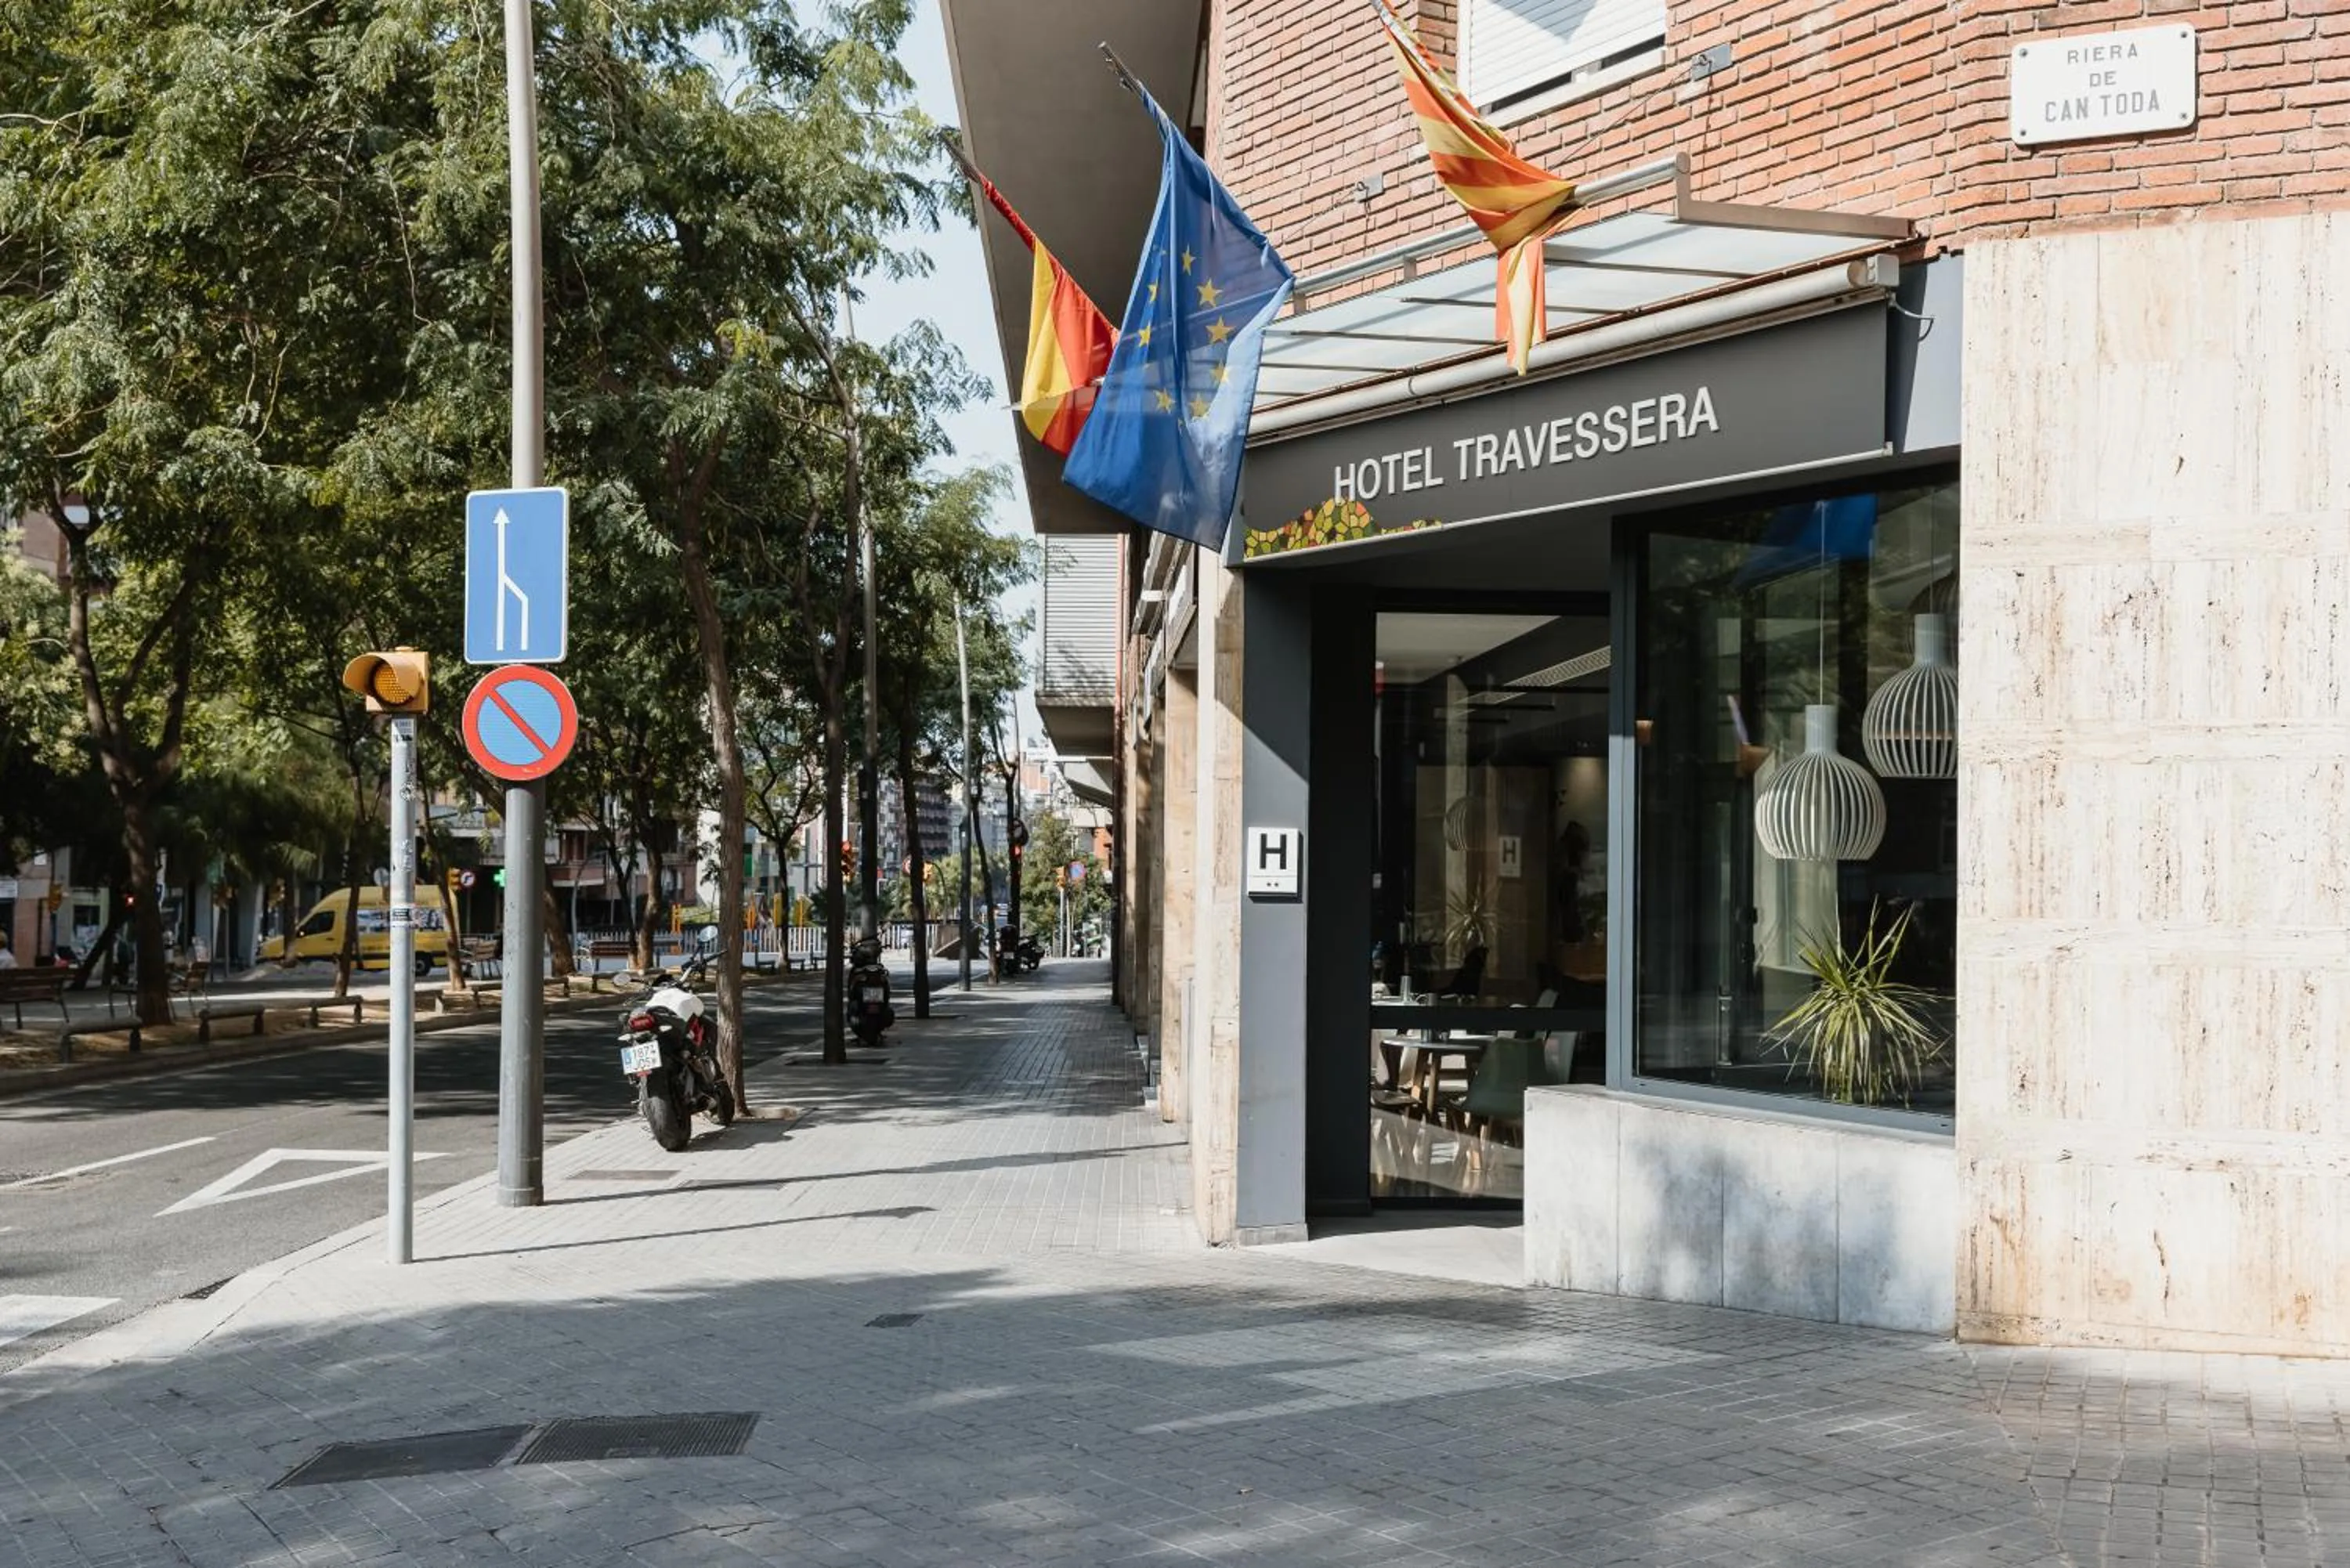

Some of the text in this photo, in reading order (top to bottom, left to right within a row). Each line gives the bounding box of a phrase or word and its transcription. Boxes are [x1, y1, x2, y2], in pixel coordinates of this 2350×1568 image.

[2067, 43, 2138, 64] RIERA
[2089, 70, 2117, 88] DE
[2044, 89, 2160, 122] CAN TODA
[1333, 386, 1719, 504] HOTEL TRAVESSERA
[1260, 833, 1286, 869] H
